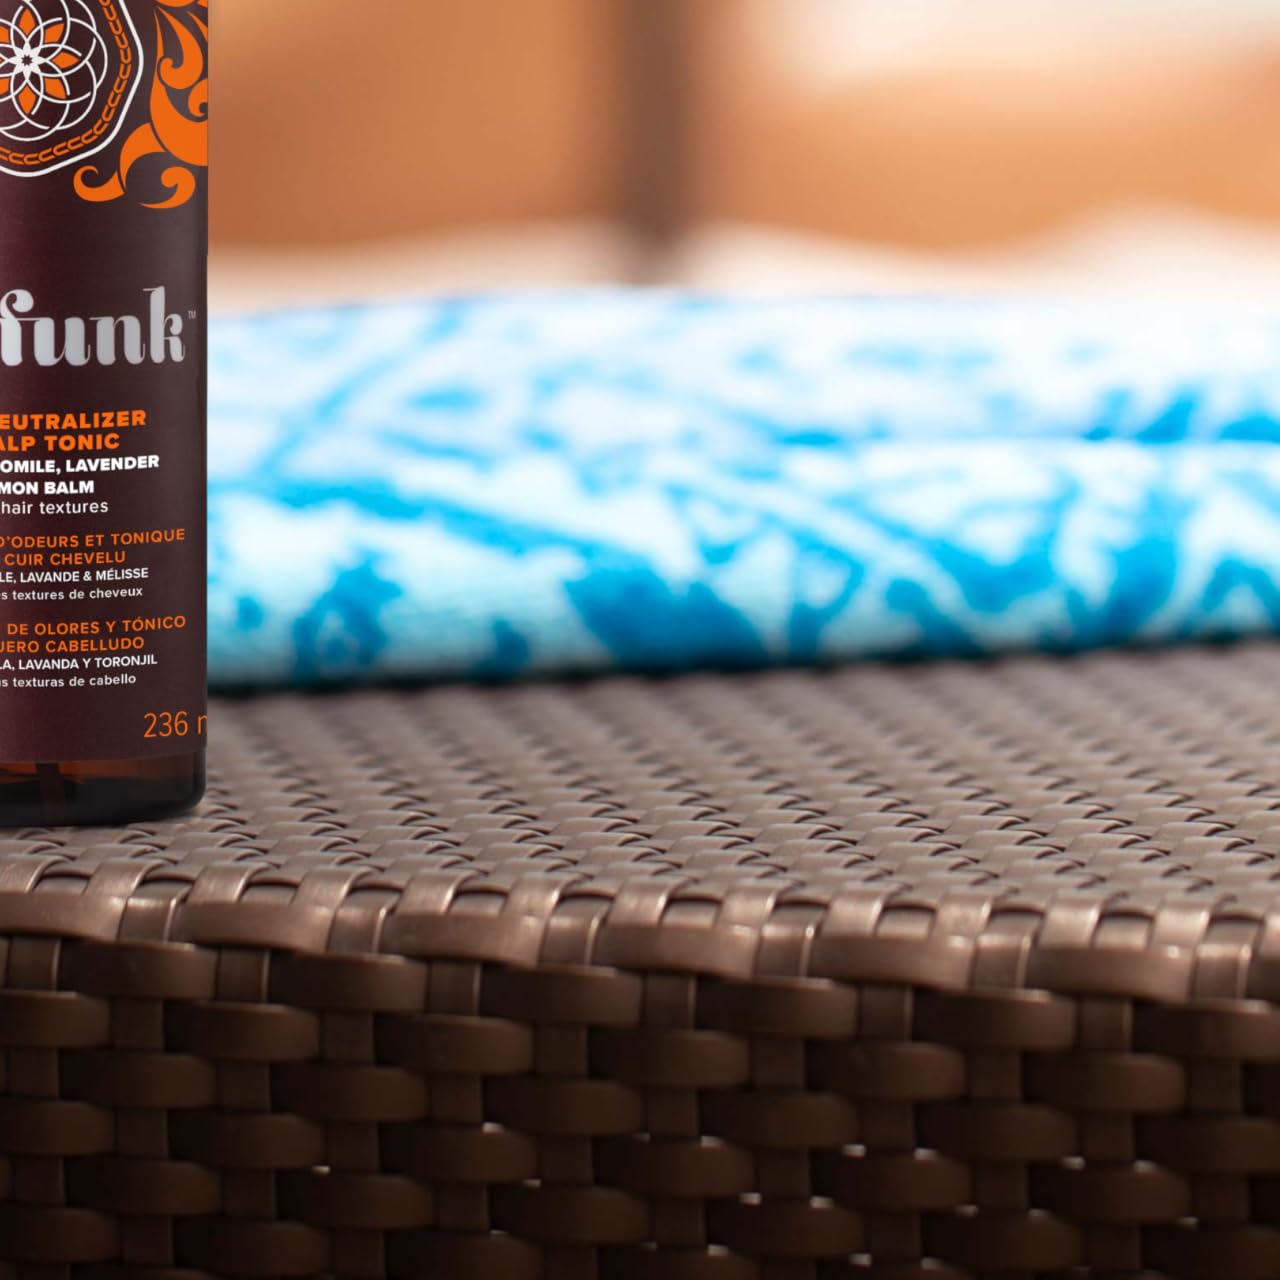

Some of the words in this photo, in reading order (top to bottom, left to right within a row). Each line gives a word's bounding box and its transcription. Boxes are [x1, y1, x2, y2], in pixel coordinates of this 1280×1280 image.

[44, 433, 120, 452] TONIC
[66, 455, 160, 473] LAVENDER
[45, 480, 95, 495] BALM
[2, 501, 34, 515] hair
[40, 502, 109, 515] textures
[85, 534, 104, 548] ET
[112, 528, 185, 546] TONIQUE
[4, 553, 44, 567] CUIR
[50, 552, 126, 567] CHEVELU
[21, 571, 80, 583] LAVANDE
[83, 571, 92, 582] &
[96, 568, 149, 581] MÉLISSE
[12, 591, 65, 601] textures
[69, 589, 85, 600] de
[90, 588, 143, 599] cheveux
[7, 624, 29, 636] DE
[34, 621, 100, 636] OLORES
[106, 621, 116, 633] Y
[123, 615, 187, 633] TÓNICO
[45, 637, 145, 654] CABELLUDO
[19, 659, 80, 670] LAVANDA
[83, 658, 92, 669] Y
[95, 654, 158, 668] TORONJIL
[13, 678, 65, 688] texturas
[69, 676, 86, 687] de
[90, 674, 137, 686] cabello
[144, 710, 189, 739] 236
